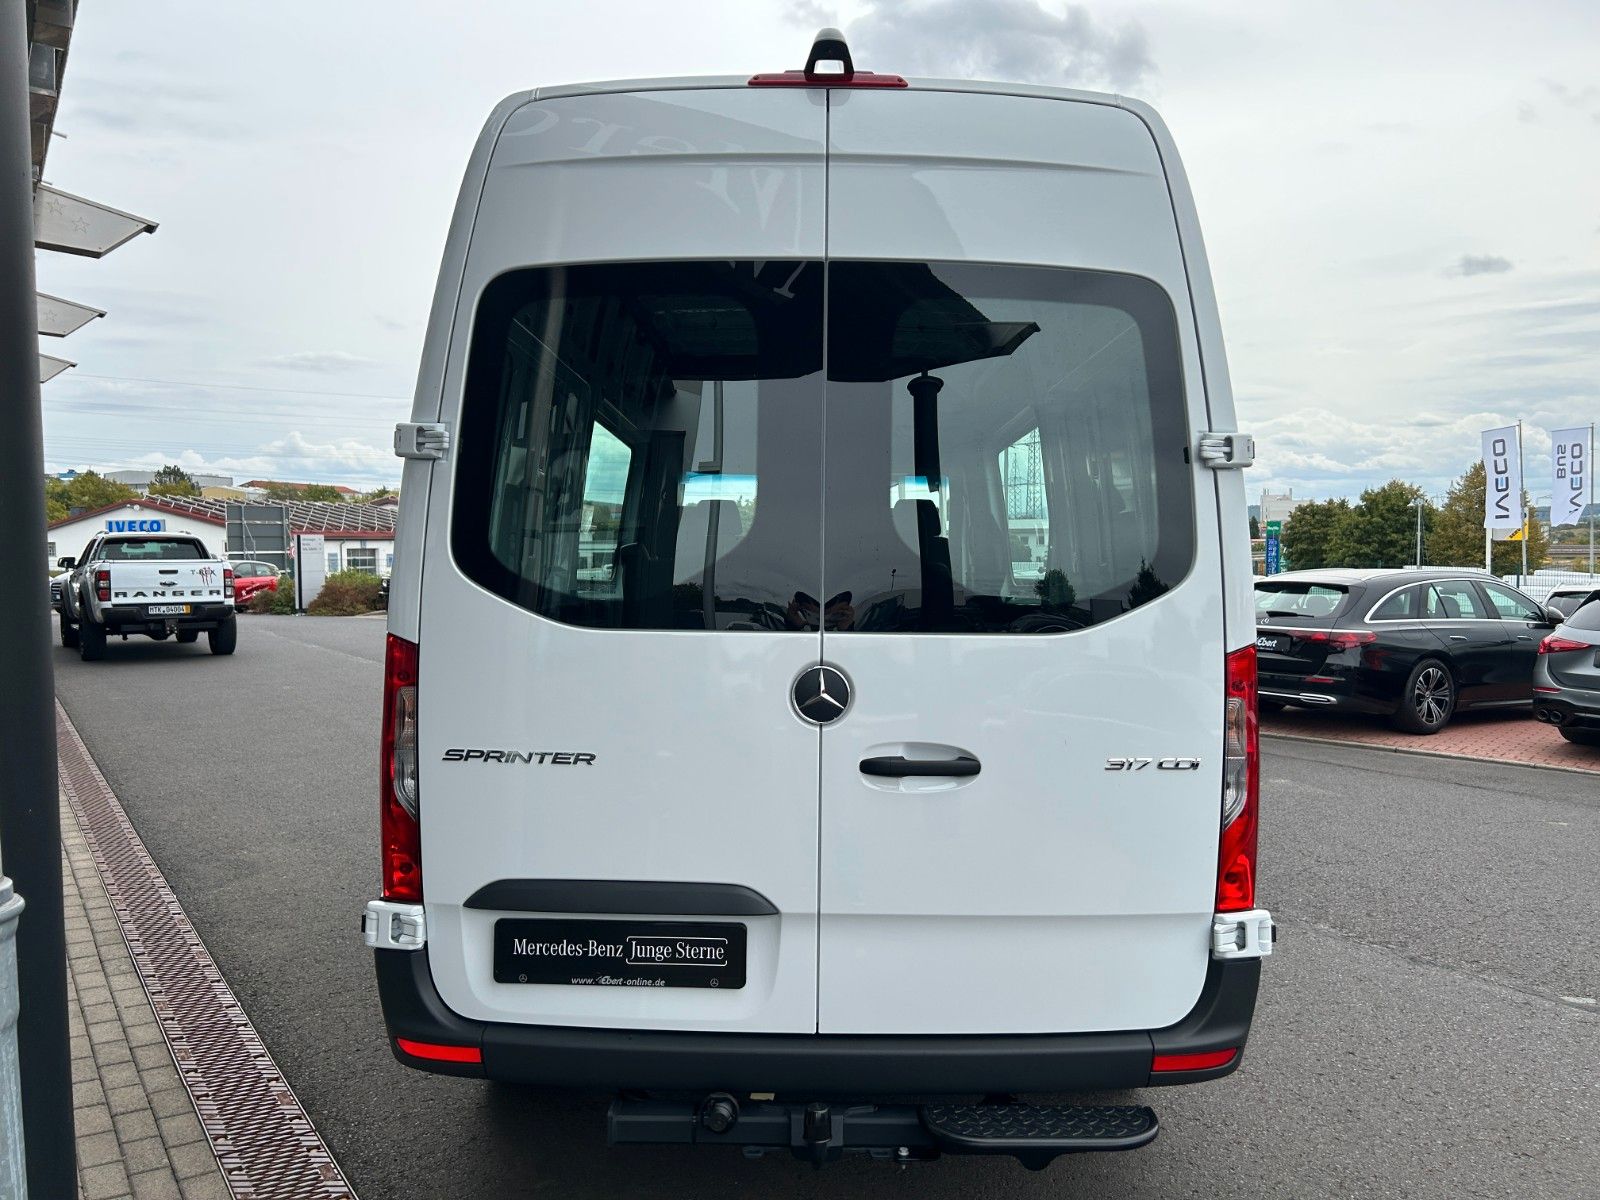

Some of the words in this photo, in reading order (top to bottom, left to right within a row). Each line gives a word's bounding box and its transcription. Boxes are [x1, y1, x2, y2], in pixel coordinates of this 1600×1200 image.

[108, 520, 161, 532] IVECO
[114, 589, 220, 598] RANGER
[442, 748, 597, 766] SPRINTER
[1105, 757, 1153, 771] 317
[1156, 757, 1202, 771] CDI
[513, 938, 624, 958] Mercedes-Benz
[630, 940, 672, 961] Junge
[675, 941, 725, 960] Sterne
